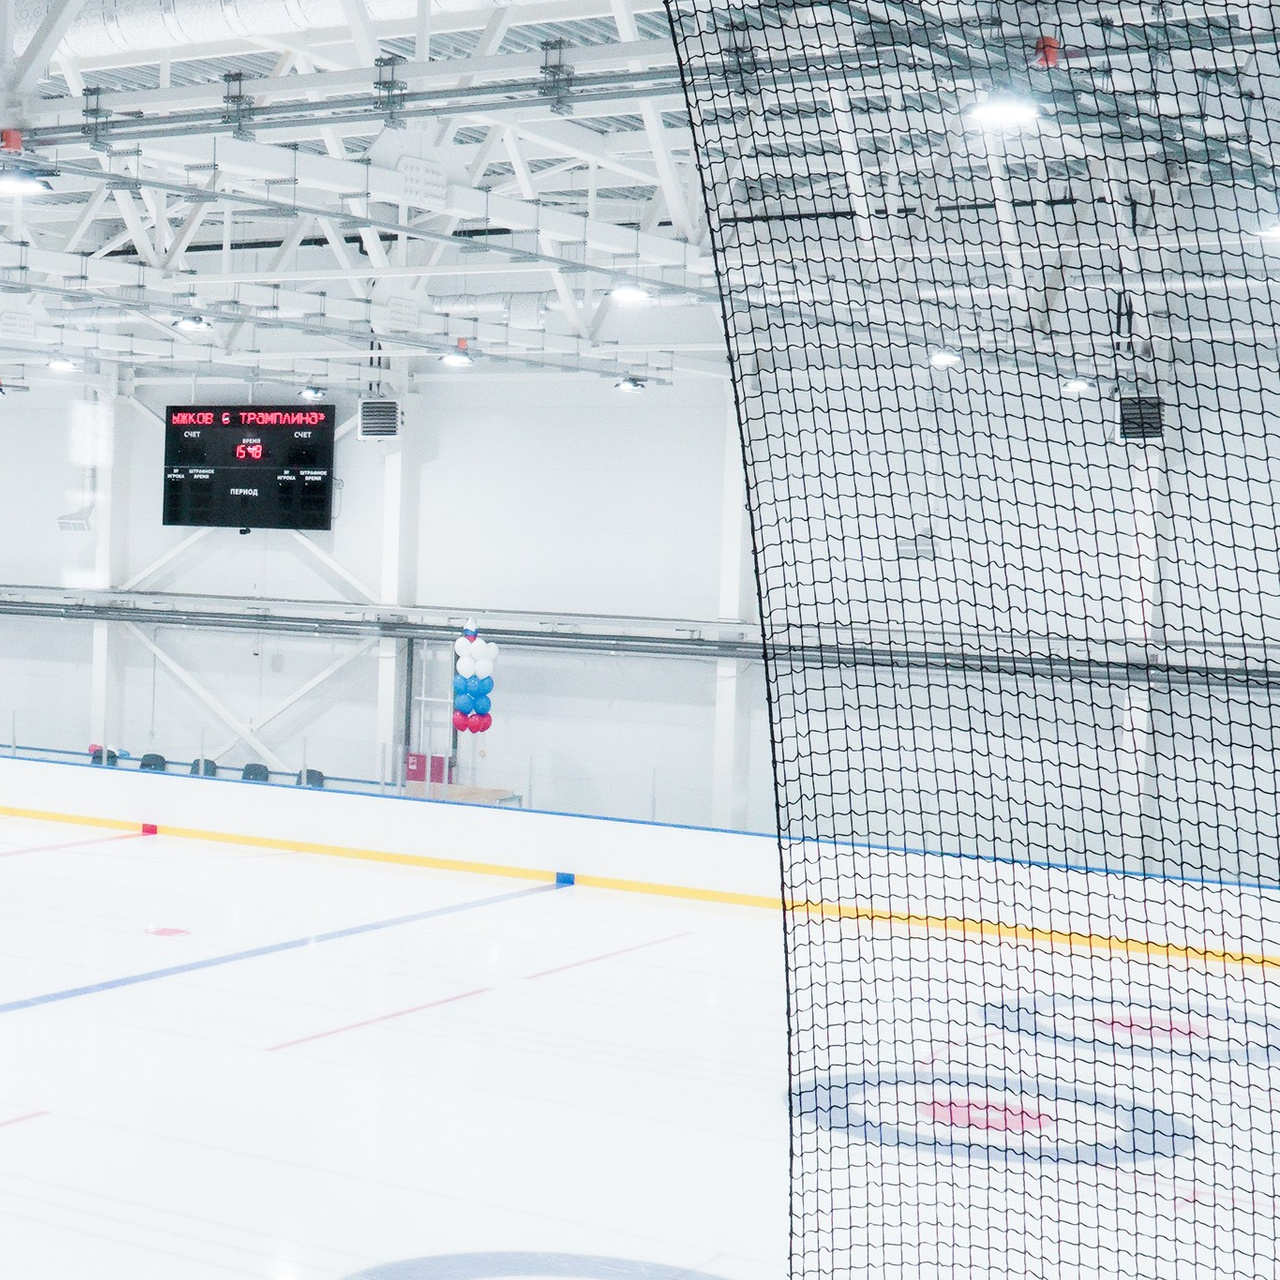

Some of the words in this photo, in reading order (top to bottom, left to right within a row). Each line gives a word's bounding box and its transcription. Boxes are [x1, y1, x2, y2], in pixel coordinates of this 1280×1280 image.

[183, 430, 201, 438] СЧЕТ
[293, 431, 312, 439] СЧЕТ
[230, 488, 259, 497] ПЕРИОД
